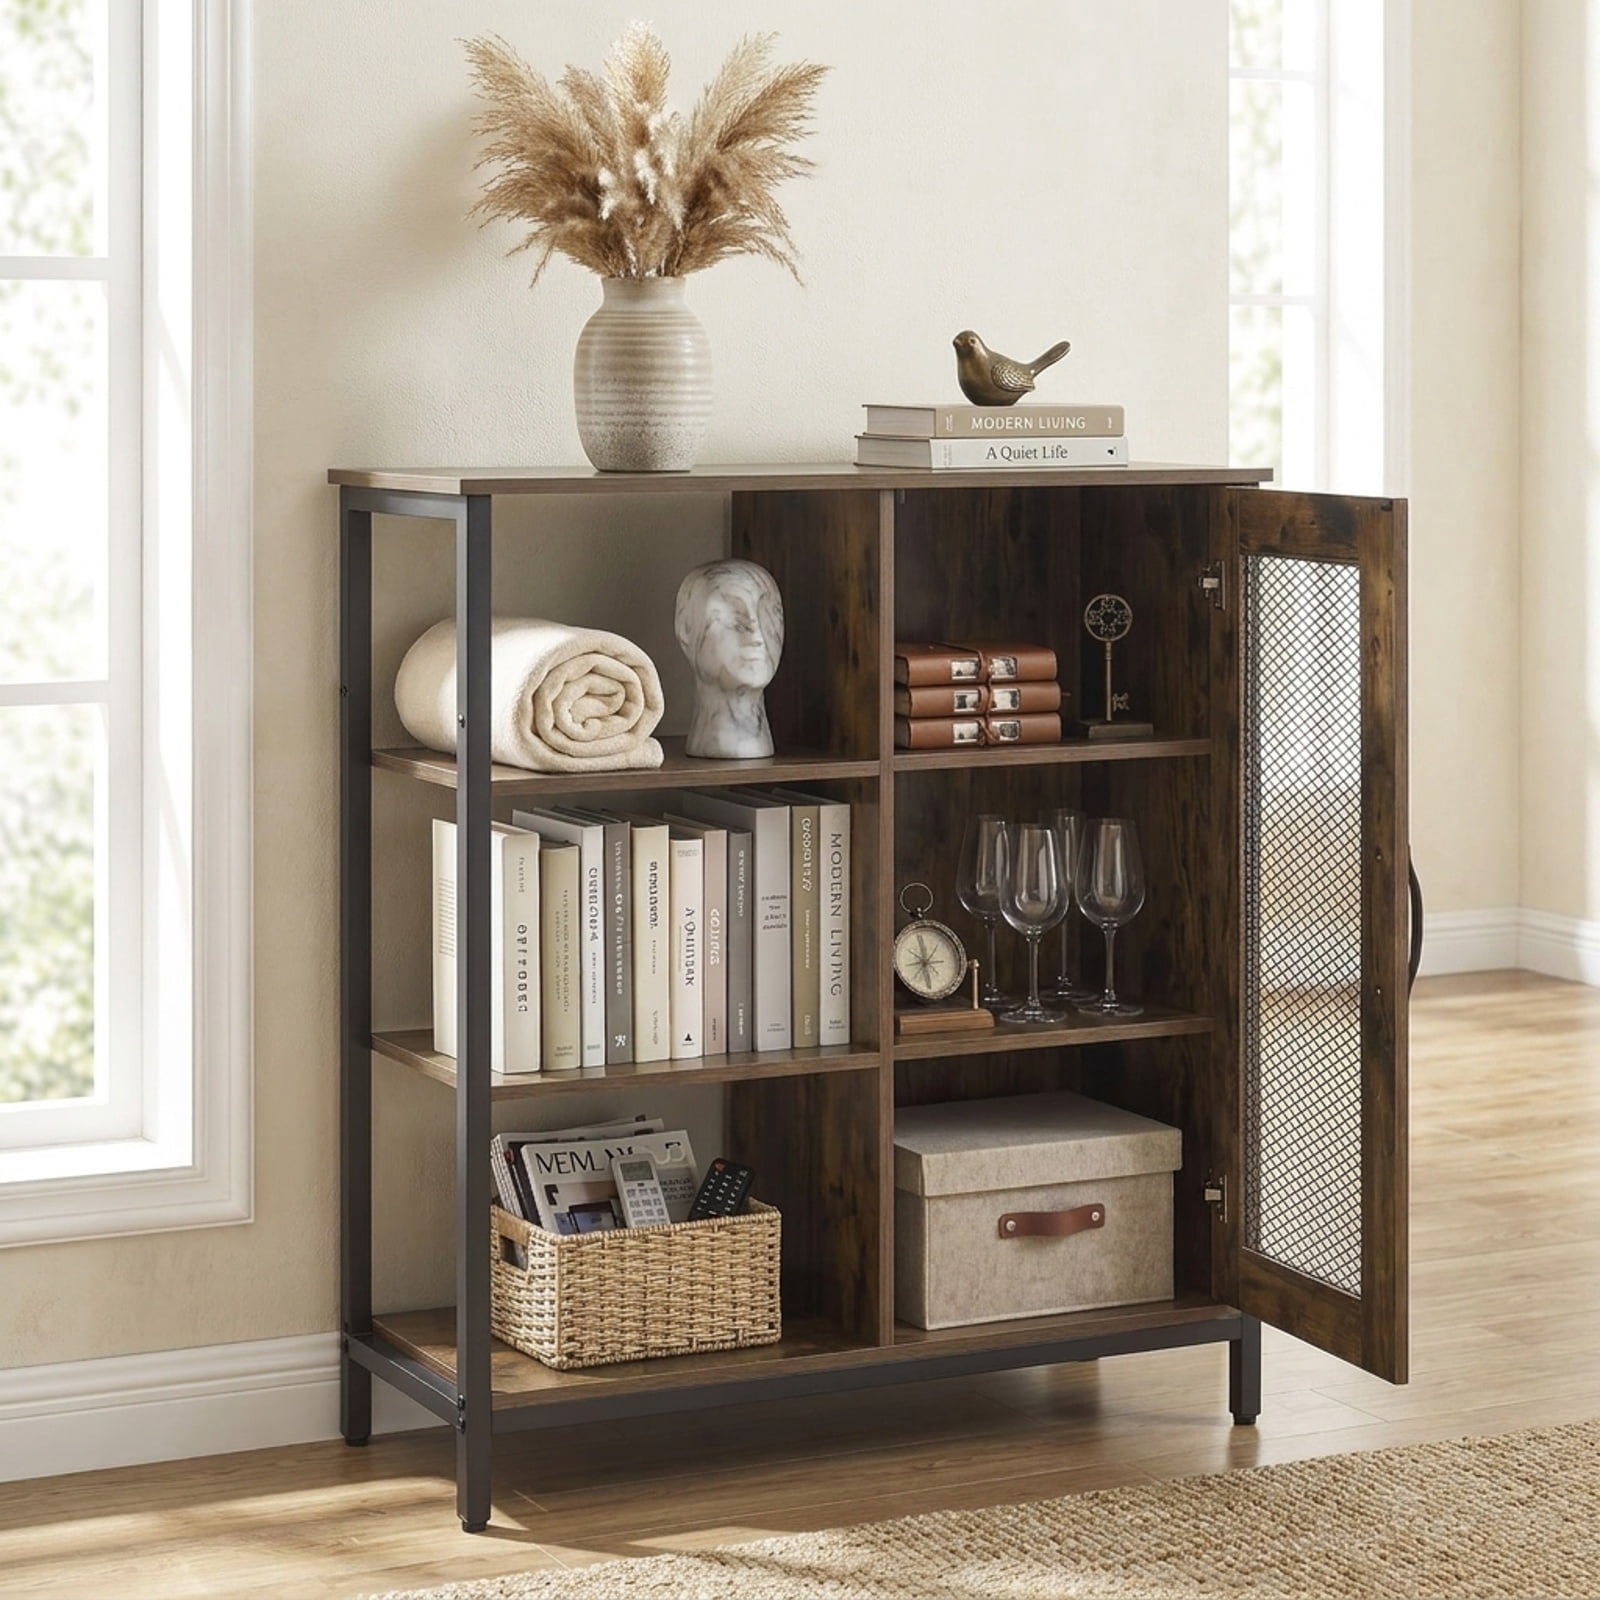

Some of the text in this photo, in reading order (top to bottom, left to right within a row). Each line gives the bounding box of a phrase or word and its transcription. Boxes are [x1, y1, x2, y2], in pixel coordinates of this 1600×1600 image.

[971, 416, 1086, 430] MODERN LIVING
[985, 445, 1069, 462] A Quiet Life
[830, 832, 843, 917] MODERN
